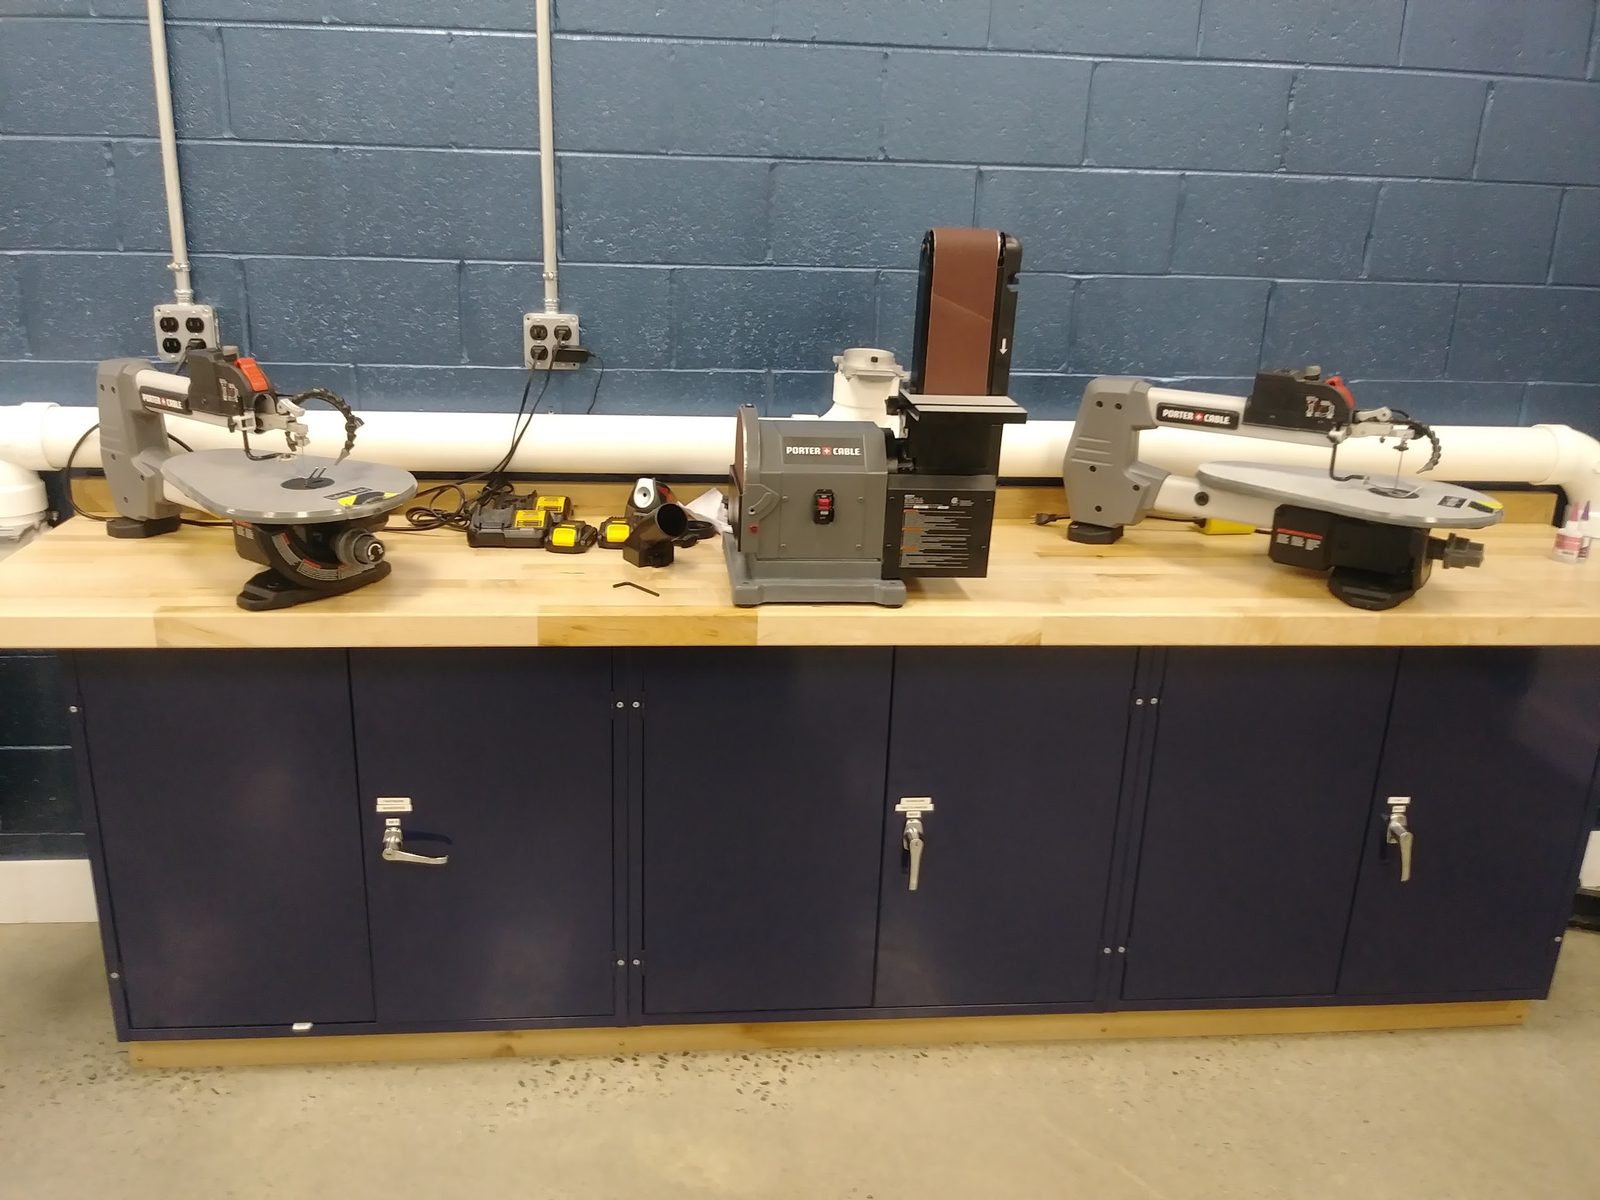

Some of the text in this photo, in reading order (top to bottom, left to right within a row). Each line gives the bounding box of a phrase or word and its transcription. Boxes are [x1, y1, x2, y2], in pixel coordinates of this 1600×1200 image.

[1162, 409, 1231, 424] PORTER CABLE
[786, 447, 862, 456] PORTER CABLE
